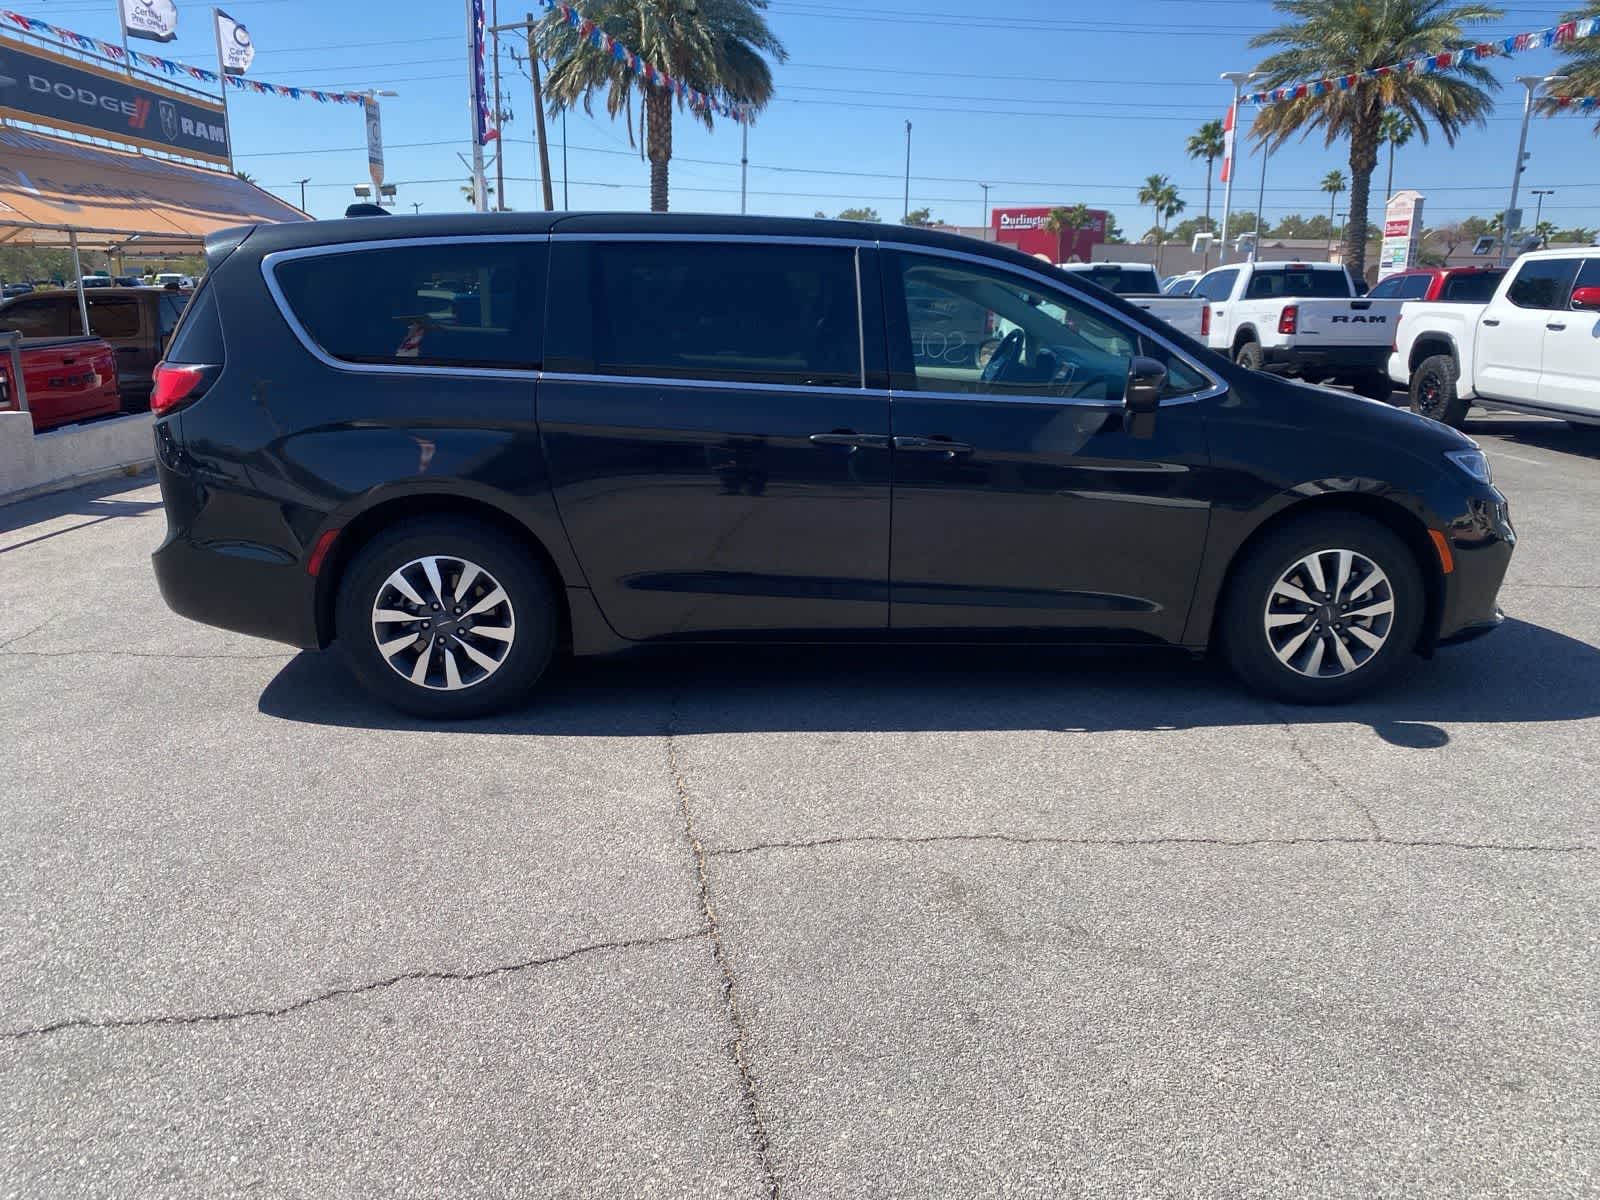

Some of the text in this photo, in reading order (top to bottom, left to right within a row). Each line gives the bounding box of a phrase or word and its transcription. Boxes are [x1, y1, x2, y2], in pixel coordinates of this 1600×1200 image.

[27, 74, 224, 143] DODGE RAM
[1332, 315, 1387, 323] RAM
